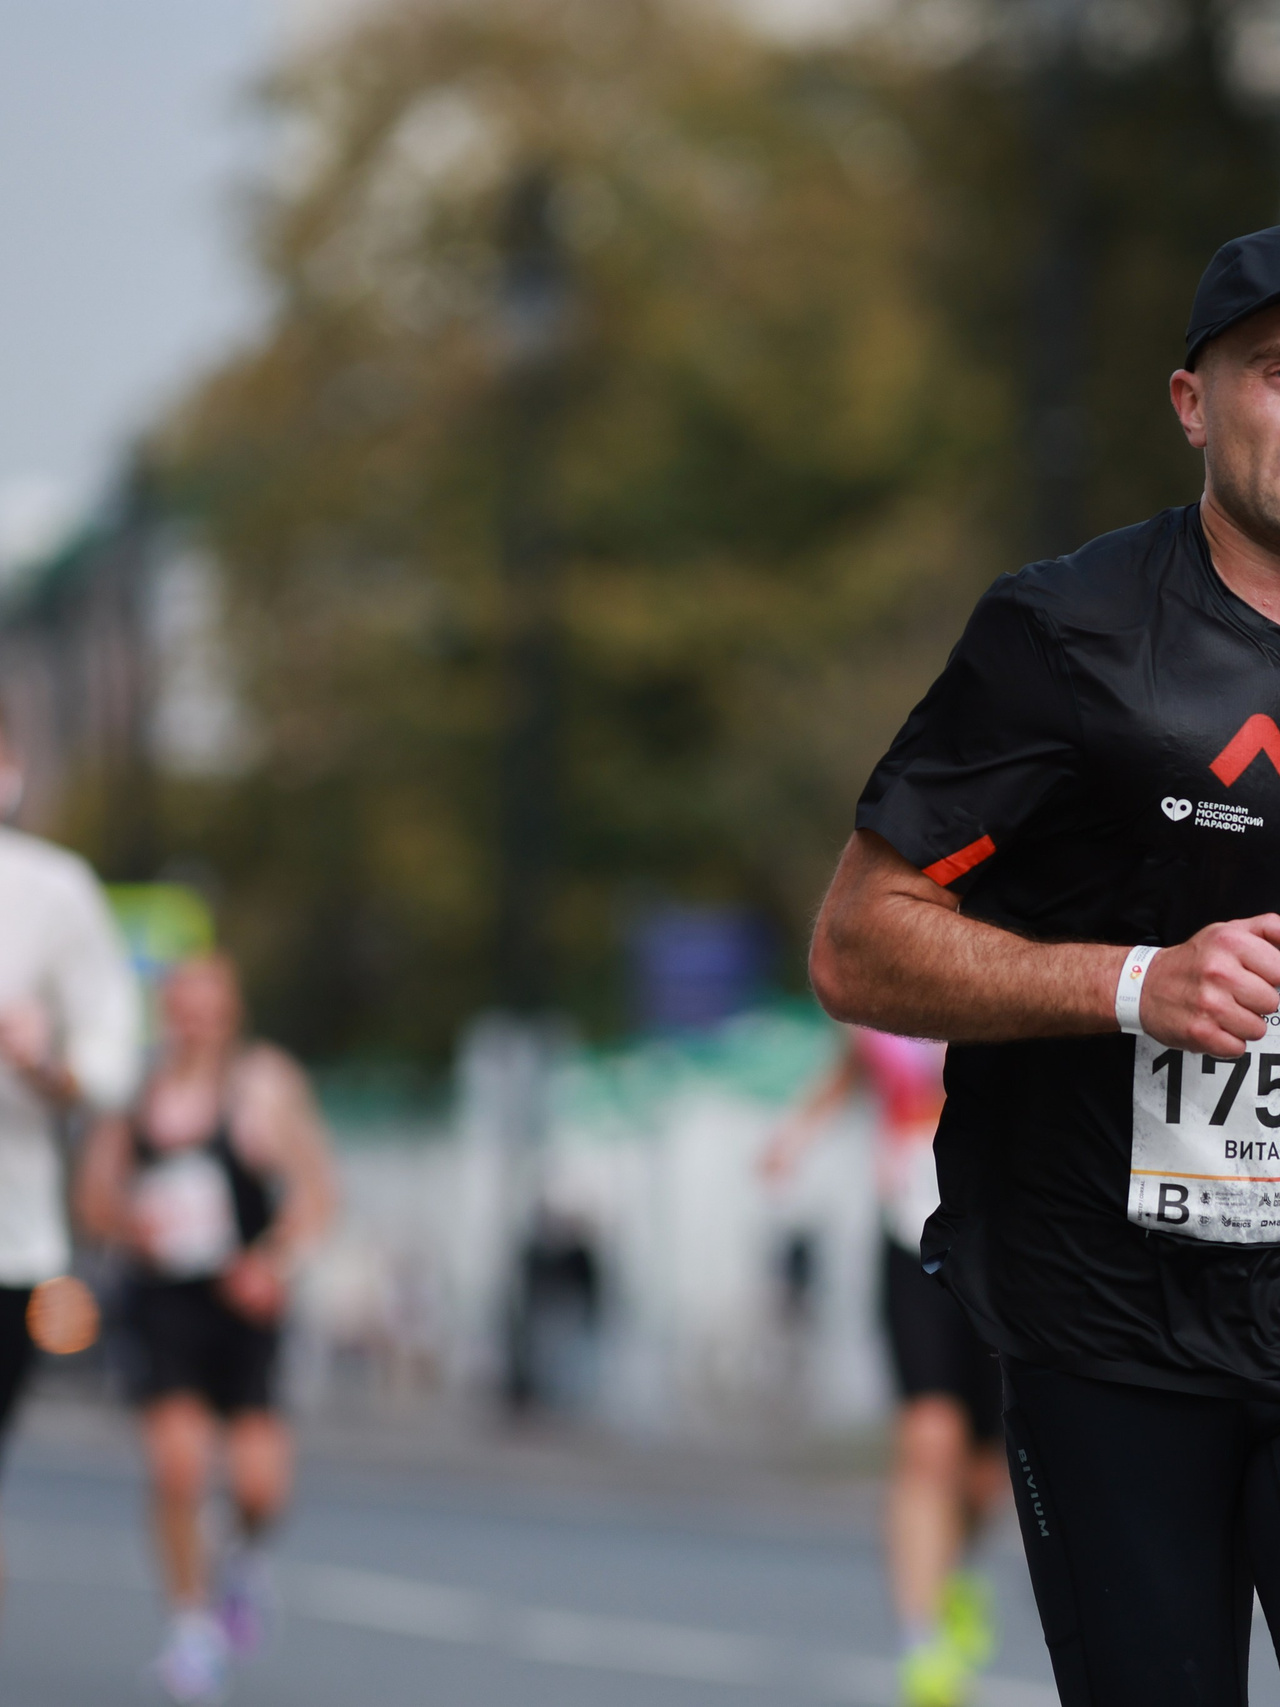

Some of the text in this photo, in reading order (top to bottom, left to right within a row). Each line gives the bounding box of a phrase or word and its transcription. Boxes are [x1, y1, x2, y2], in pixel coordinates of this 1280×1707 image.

[1198, 801, 1249, 815] СБЕРПРАЙМ
[1194, 818, 1246, 833] МАРАФОН
[1196, 808, 1264, 827] МОСКОВСКИЙ
[1018, 1449, 1050, 1537] BIVIUM
